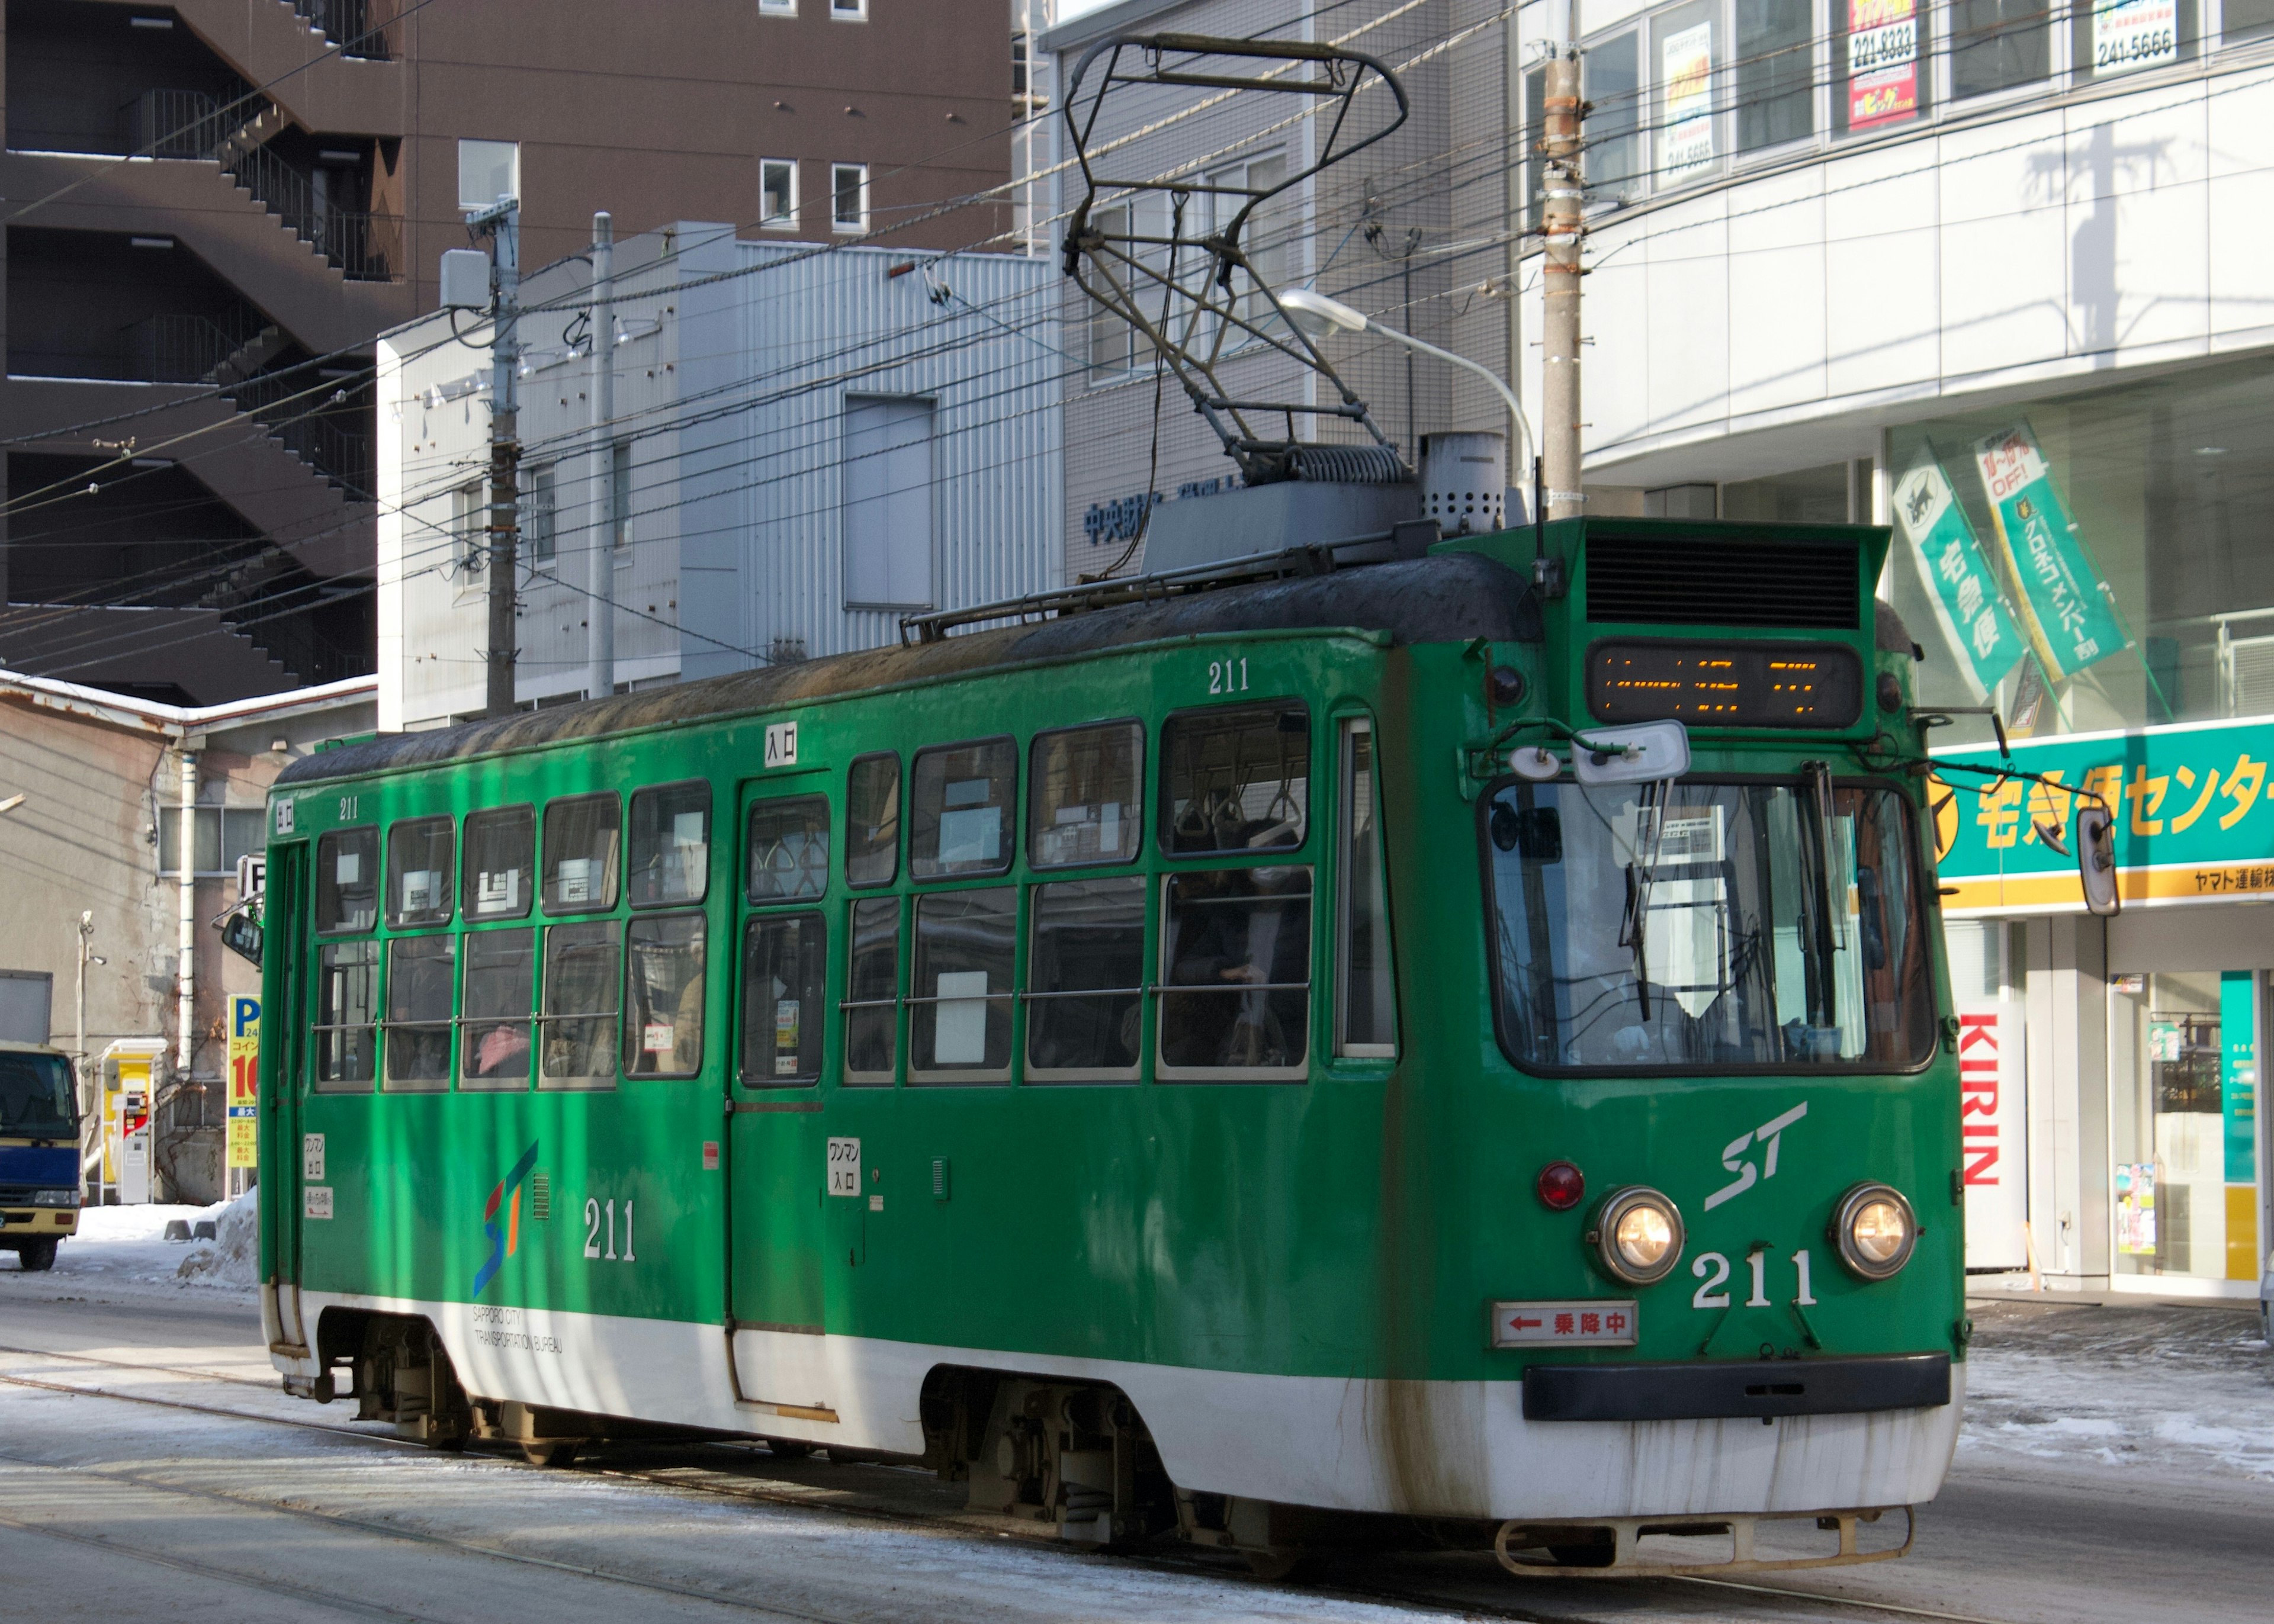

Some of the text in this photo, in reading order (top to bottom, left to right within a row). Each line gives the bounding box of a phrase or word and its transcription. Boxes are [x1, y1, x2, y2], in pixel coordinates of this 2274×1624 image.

[1855, 25, 1910, 67] 221-8333
[2098, 28, 2172, 67] 241-5666
[1084, 492, 1164, 545] 中央財
[1939, 538, 2000, 660] 宅急便
[2025, 519, 2099, 661] クロネコメンバー割
[1209, 657, 1249, 694] 211
[768, 728, 794, 760] 入口
[278, 804, 293, 828] 出口
[340, 796, 358, 820] 211
[1976, 753, 2274, 849] 宅急便センタ
[236, 998, 261, 1037] P
[237, 1107, 255, 1116] 最大
[1960, 1013, 2000, 1185] KIRIN
[306, 1138, 323, 1152] ワンマン
[830, 1143, 859, 1162] ワンマン
[835, 1171, 854, 1190] 入口
[584, 1197, 635, 1262] 211
[1692, 1249, 1817, 1308] 211
[473, 1306, 521, 1325] SAPPORO CITY
[1554, 1311, 1626, 1335] 乗降中
[475, 1330, 563, 1354] TRANSPORTATION BUREAU
